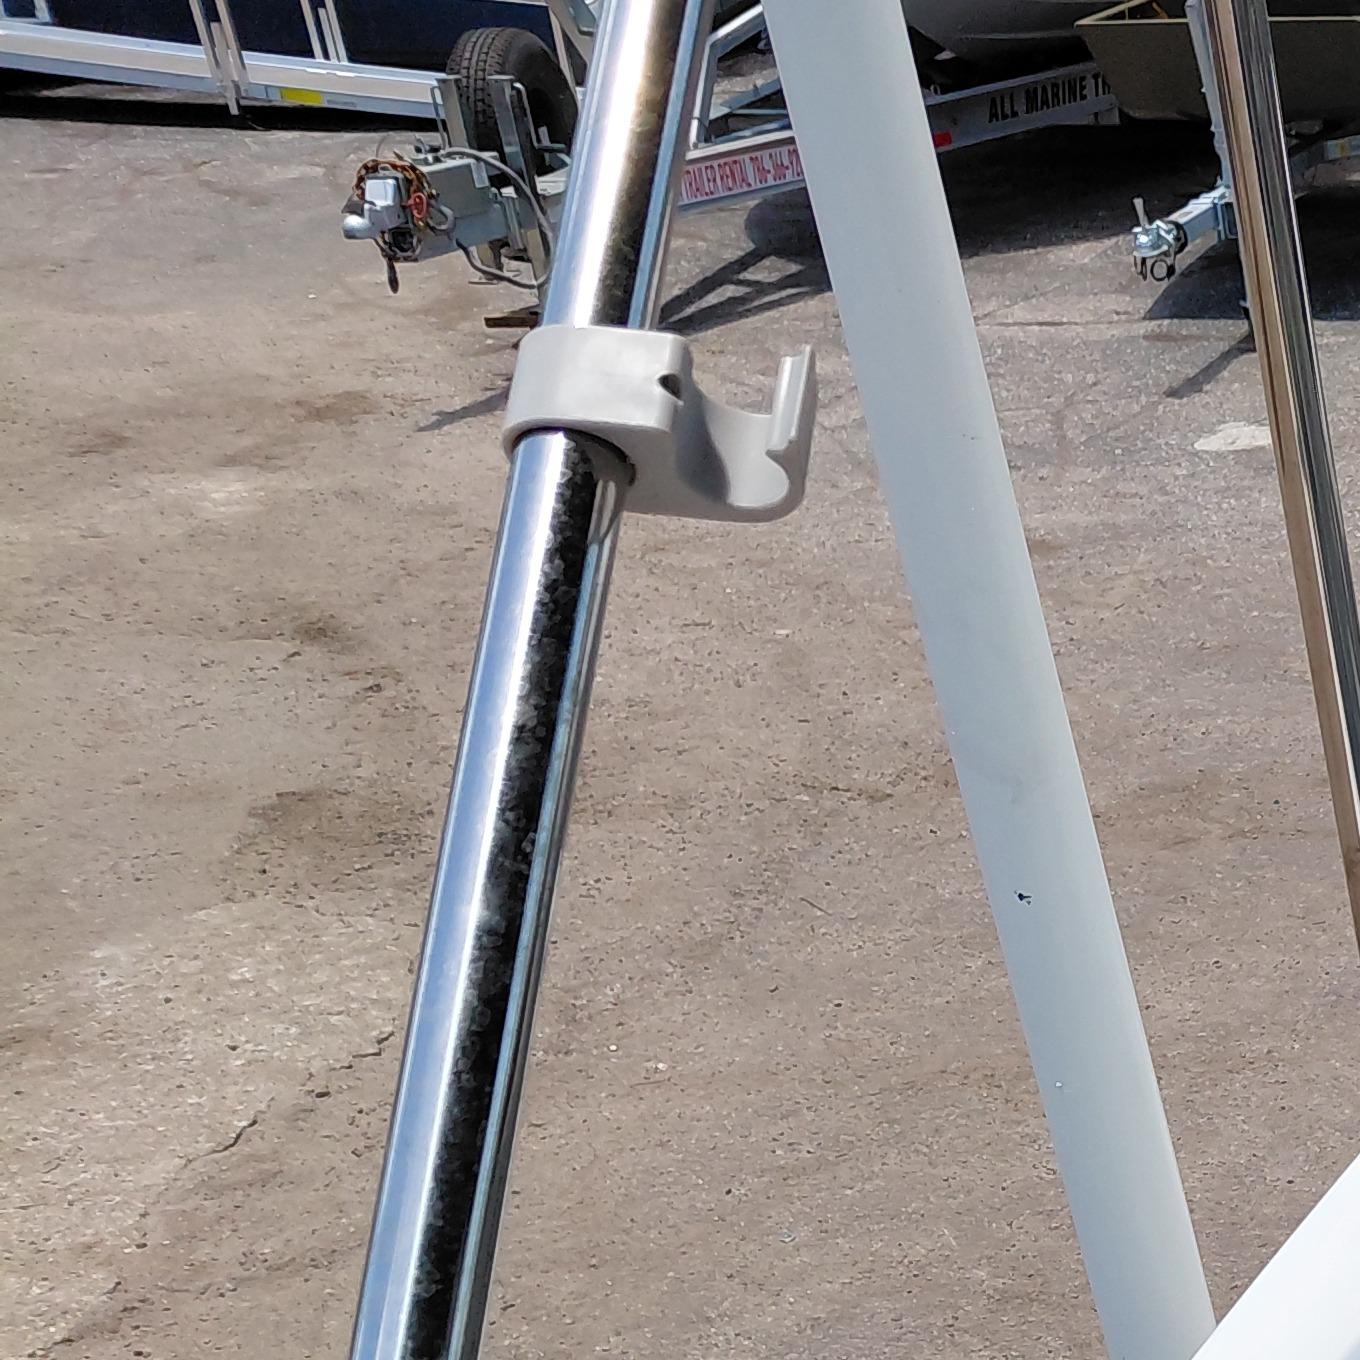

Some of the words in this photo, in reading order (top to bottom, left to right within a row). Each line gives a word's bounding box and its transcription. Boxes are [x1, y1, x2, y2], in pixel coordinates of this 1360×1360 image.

[988, 93, 1018, 123] ALL
[1024, 75, 1087, 114] MARINE
[717, 157, 752, 192] RENTAL
